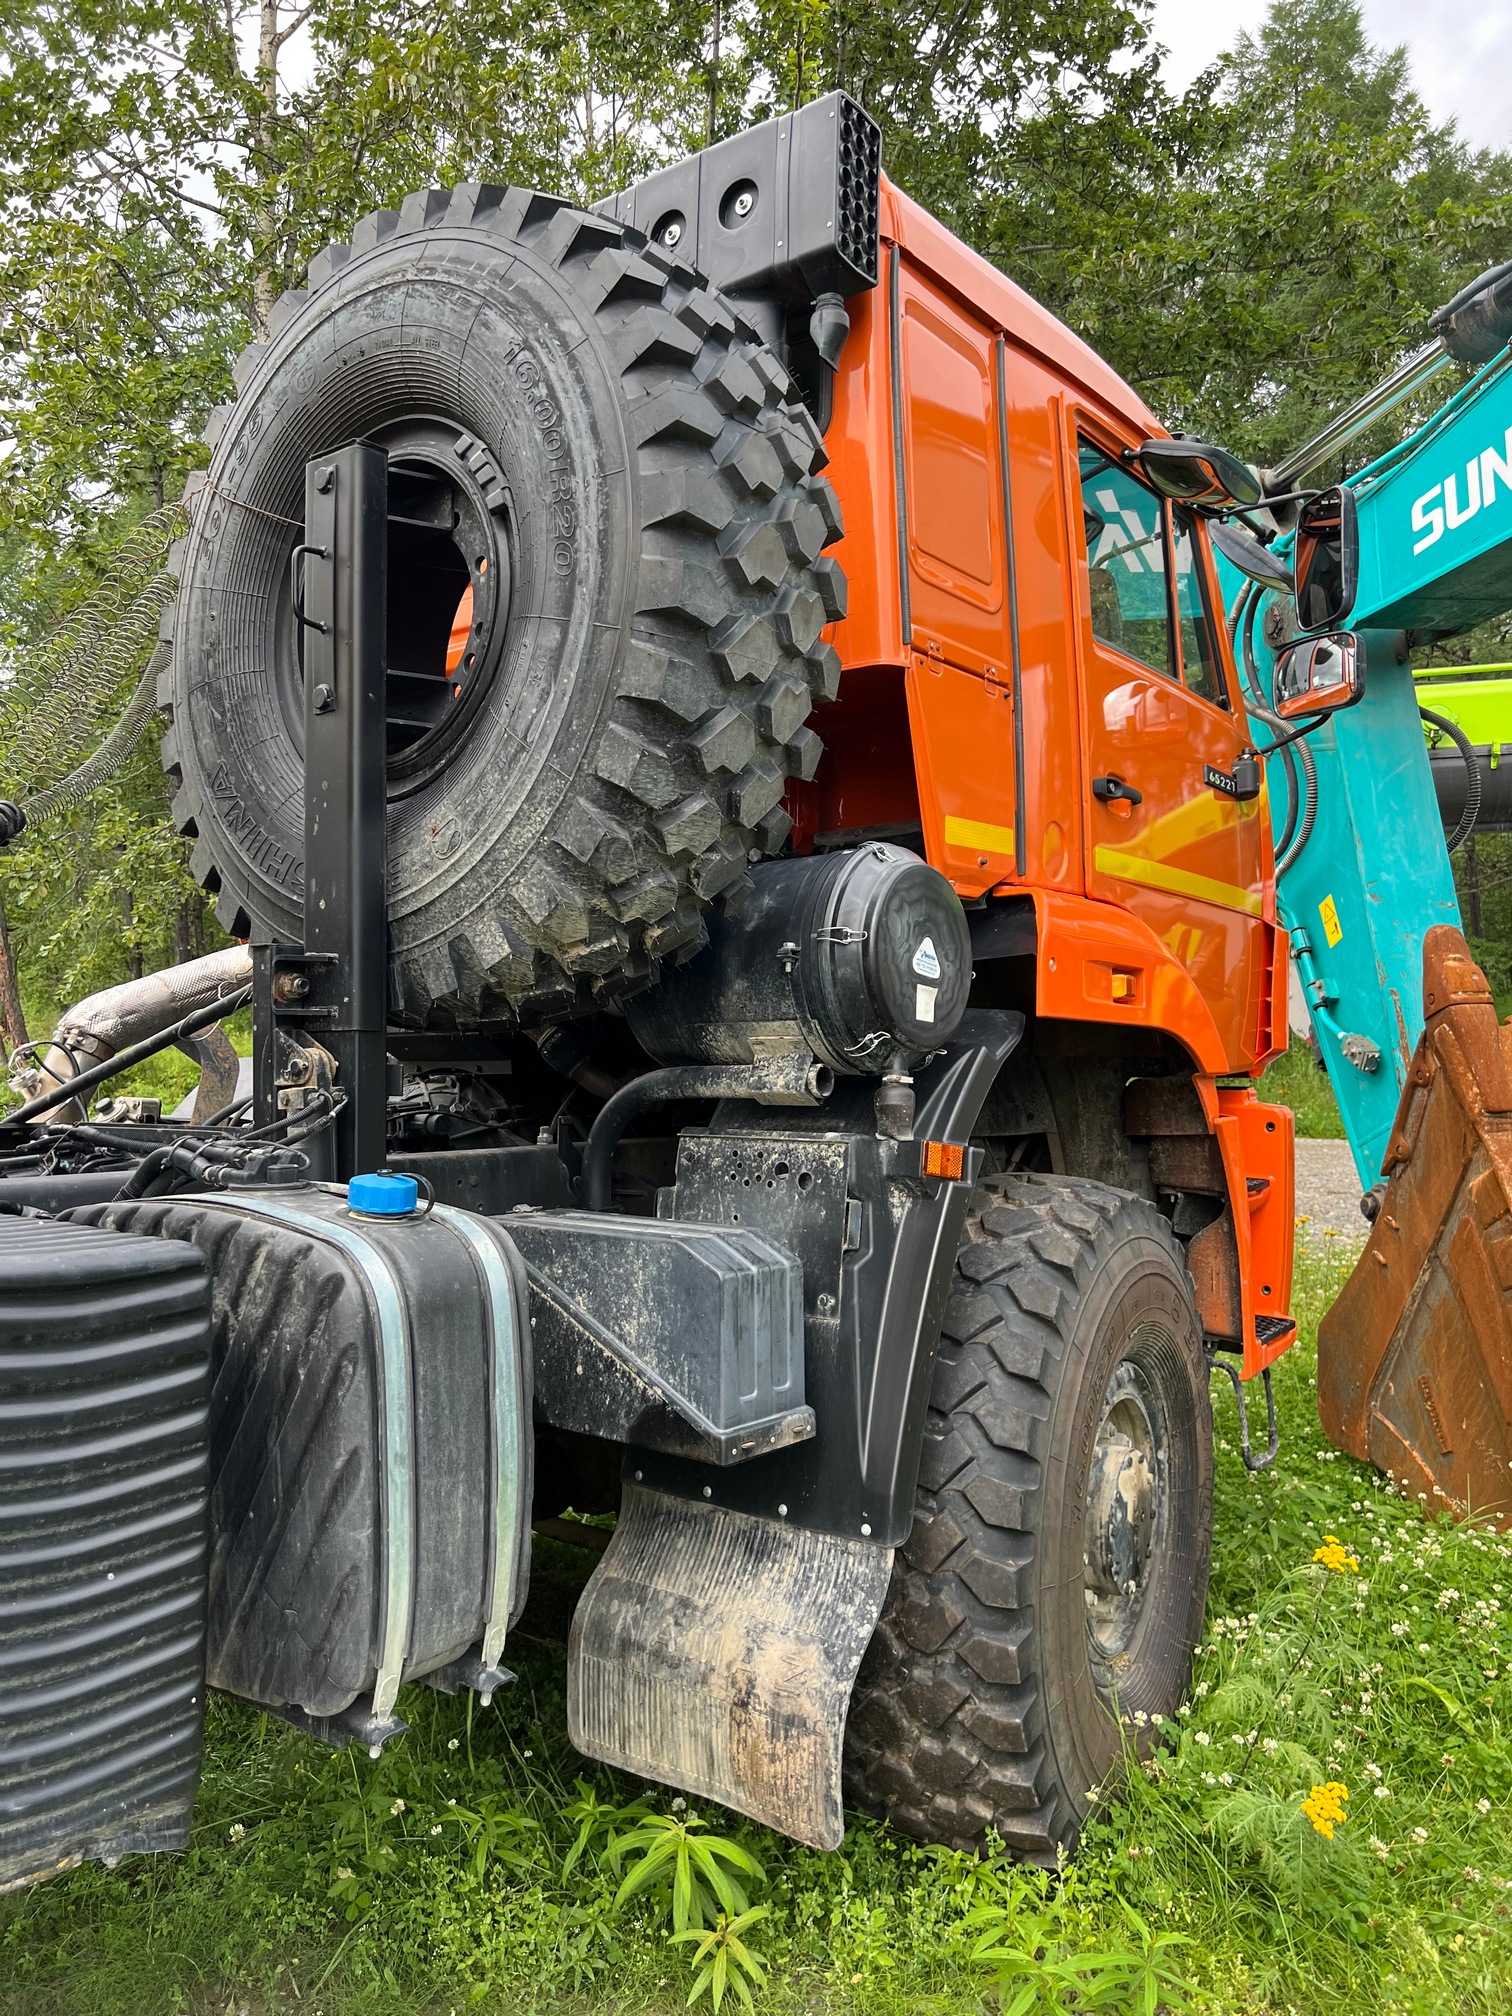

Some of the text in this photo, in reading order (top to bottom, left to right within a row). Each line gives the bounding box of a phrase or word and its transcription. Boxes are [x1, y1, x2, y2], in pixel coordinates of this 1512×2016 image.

[502, 337, 576, 577] 16.00R20
[1411, 425, 1512, 556] SUN
[1209, 771, 1236, 792] 65221
